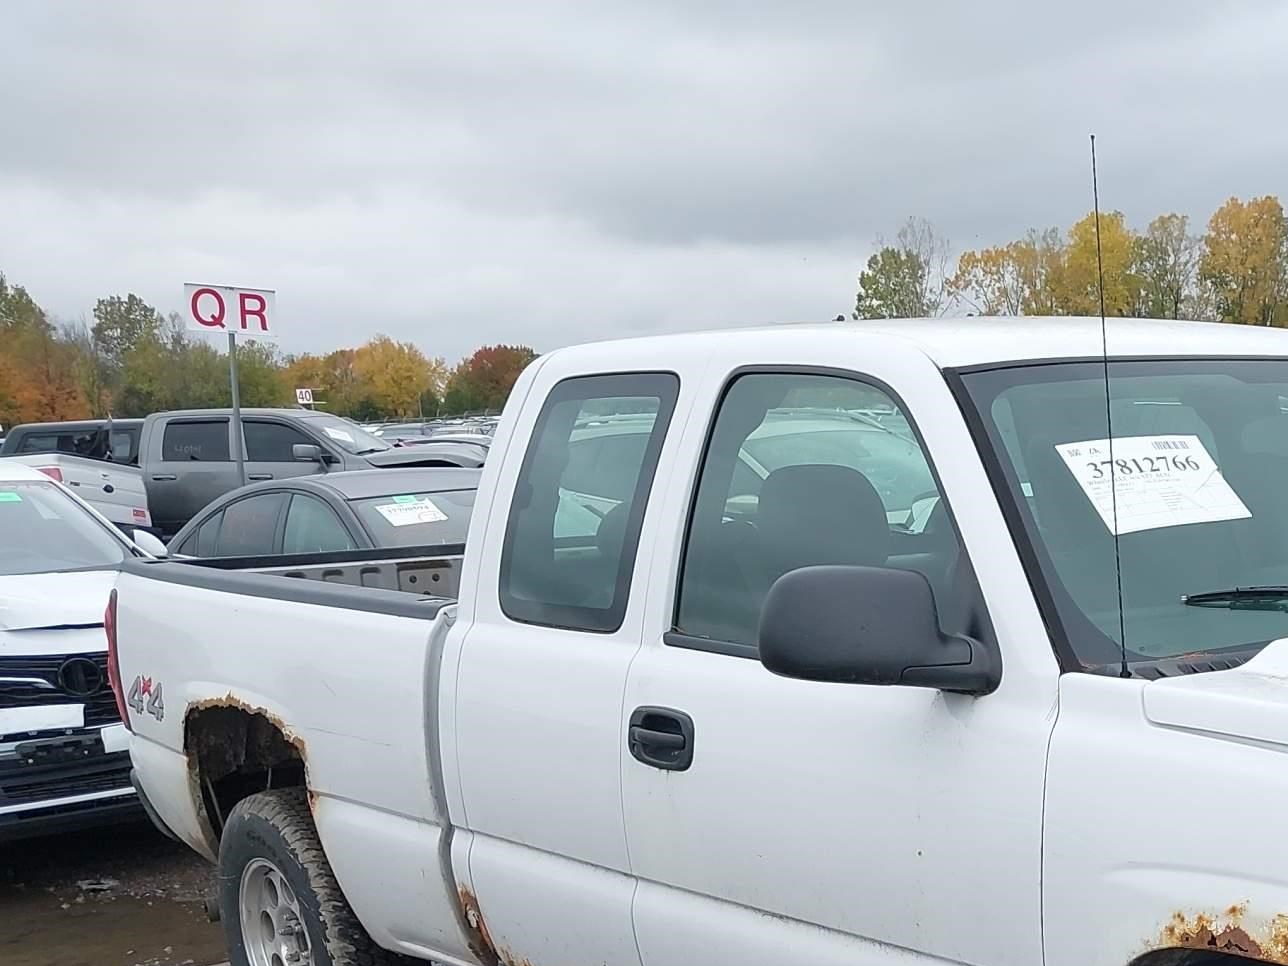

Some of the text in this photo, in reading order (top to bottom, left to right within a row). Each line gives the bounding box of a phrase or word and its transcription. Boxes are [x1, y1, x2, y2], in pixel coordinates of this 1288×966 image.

[191, 288, 268, 331] Q R
[298, 390, 312, 402] 40
[1087, 454, 1200, 479] 37812766
